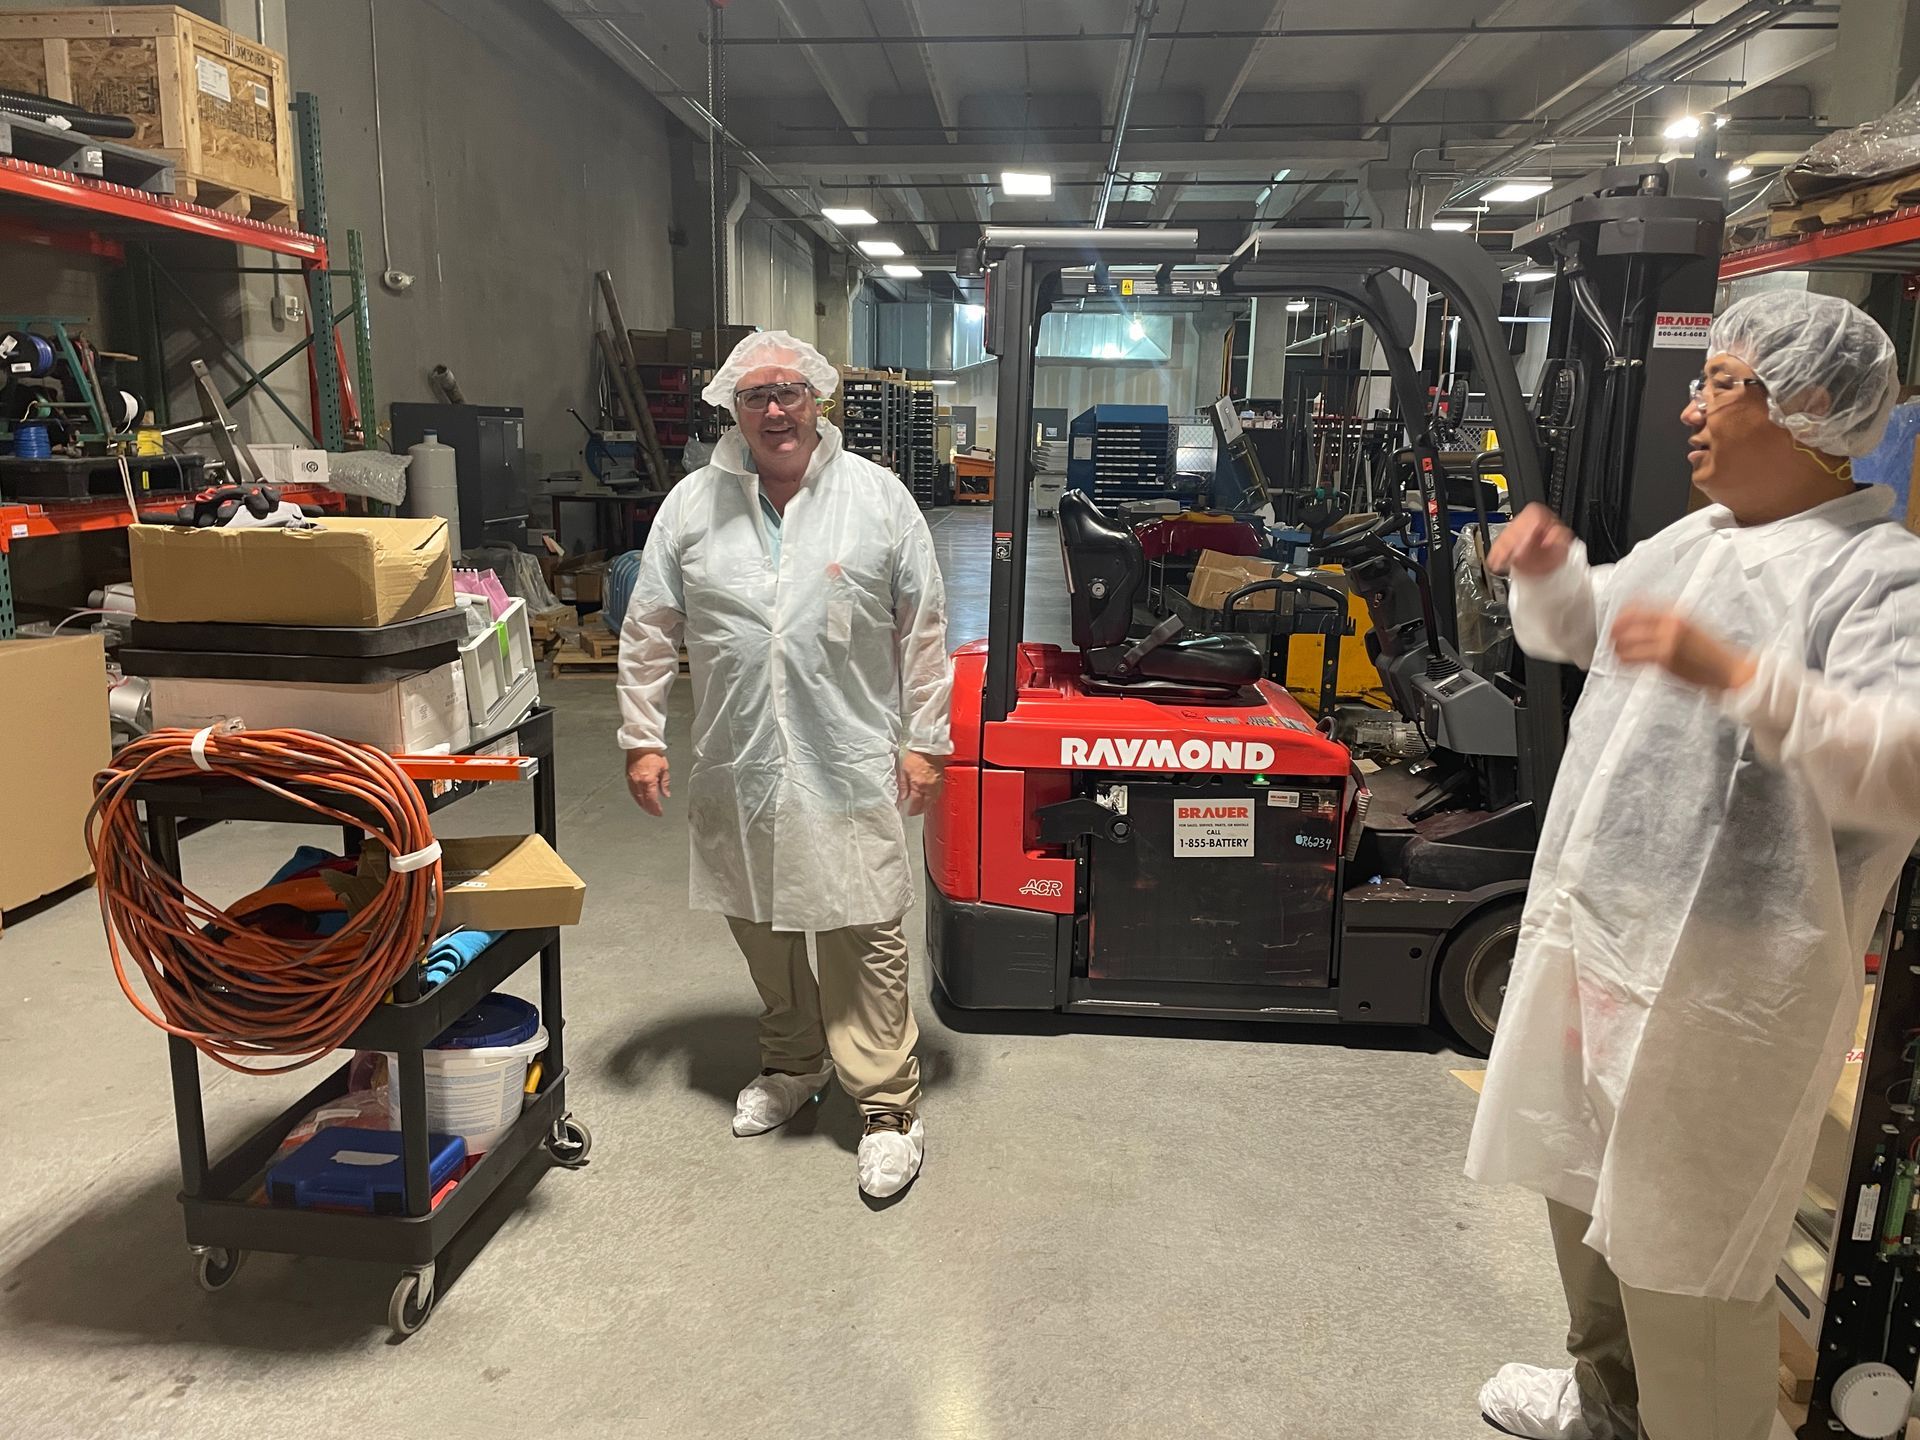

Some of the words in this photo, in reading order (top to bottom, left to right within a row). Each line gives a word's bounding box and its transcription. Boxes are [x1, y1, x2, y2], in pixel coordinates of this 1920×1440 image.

[1657, 316, 1711, 326] BRAUER
[1061, 738, 1275, 770] RAYMOND
[1178, 807, 1248, 818] BRAUER
[1180, 838, 1249, 848] 1-855-BATTERY
[1019, 879, 1063, 896] ACR
